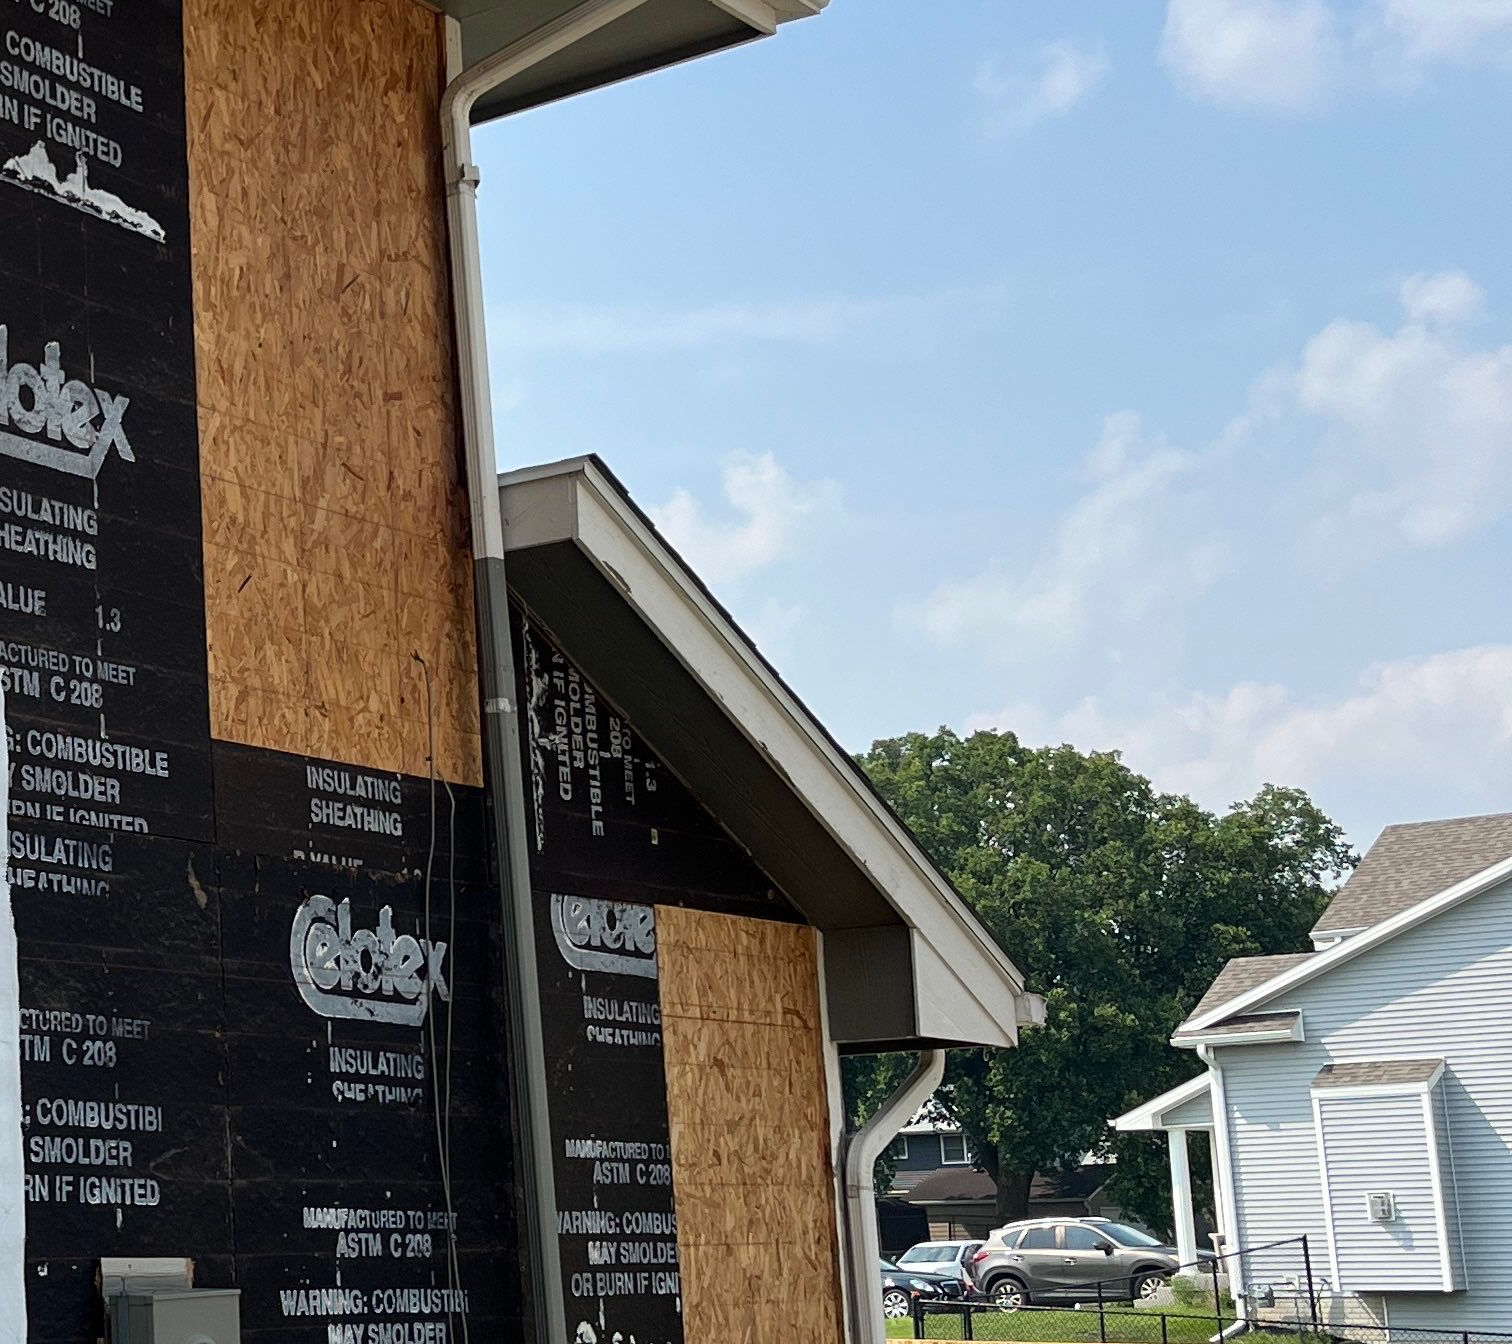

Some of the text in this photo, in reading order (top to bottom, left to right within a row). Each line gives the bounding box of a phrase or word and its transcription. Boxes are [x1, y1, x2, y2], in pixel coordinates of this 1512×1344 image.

[5, 30, 144, 113] COMBUSTIBLE
[0, 60, 98, 124] SMOLDER
[23, 103, 42, 131] IF
[46, 113, 123, 169] IGNITED
[94, 605, 122, 634] 1.3
[72, 655, 93, 680] TO
[96, 660, 136, 688] MEET
[552, 671, 566, 696] IF
[49, 675, 66, 703] C
[70, 679, 104, 709] 208
[568, 666, 585, 770] MOLDER
[26, 728, 170, 779] COMBUSTIBLE
[553, 698, 573, 802] IGNITED
[609, 716, 623, 759] 208
[21, 763, 121, 805] SMOLDER
[305, 764, 403, 805] INSULATING
[623, 754, 636, 806] MEET
[309, 797, 403, 837] SHEATHING
[8, 829, 114, 872] SULATING
[289, 894, 453, 1027] Celotex
[85, 1012, 108, 1037] TO
[110, 1017, 152, 1041] MEET
[583, 995, 662, 1026] INSULATING
[61, 1038, 78, 1066] C
[81, 1040, 118, 1068] 208
[328, 1046, 425, 1081] INSULATING
[29, 1135, 134, 1167] SMOLDER
[564, 1138, 665, 1161] MANUFACTURED TO
[592, 1160, 671, 1186] ASTM C 208
[54, 1174, 75, 1203] IF
[79, 1176, 161, 1207] IGNITED
[302, 1206, 405, 1230] MANUFACTURED
[406, 1209, 425, 1229] TO
[335, 1231, 433, 1259] ASTM C 208
[587, 1239, 618, 1266] MAY
[570, 1271, 594, 1297] OR
[595, 1271, 635, 1297] BURN
[636, 1271, 650, 1296] IF
[280, 1289, 369, 1317] WARNING:
